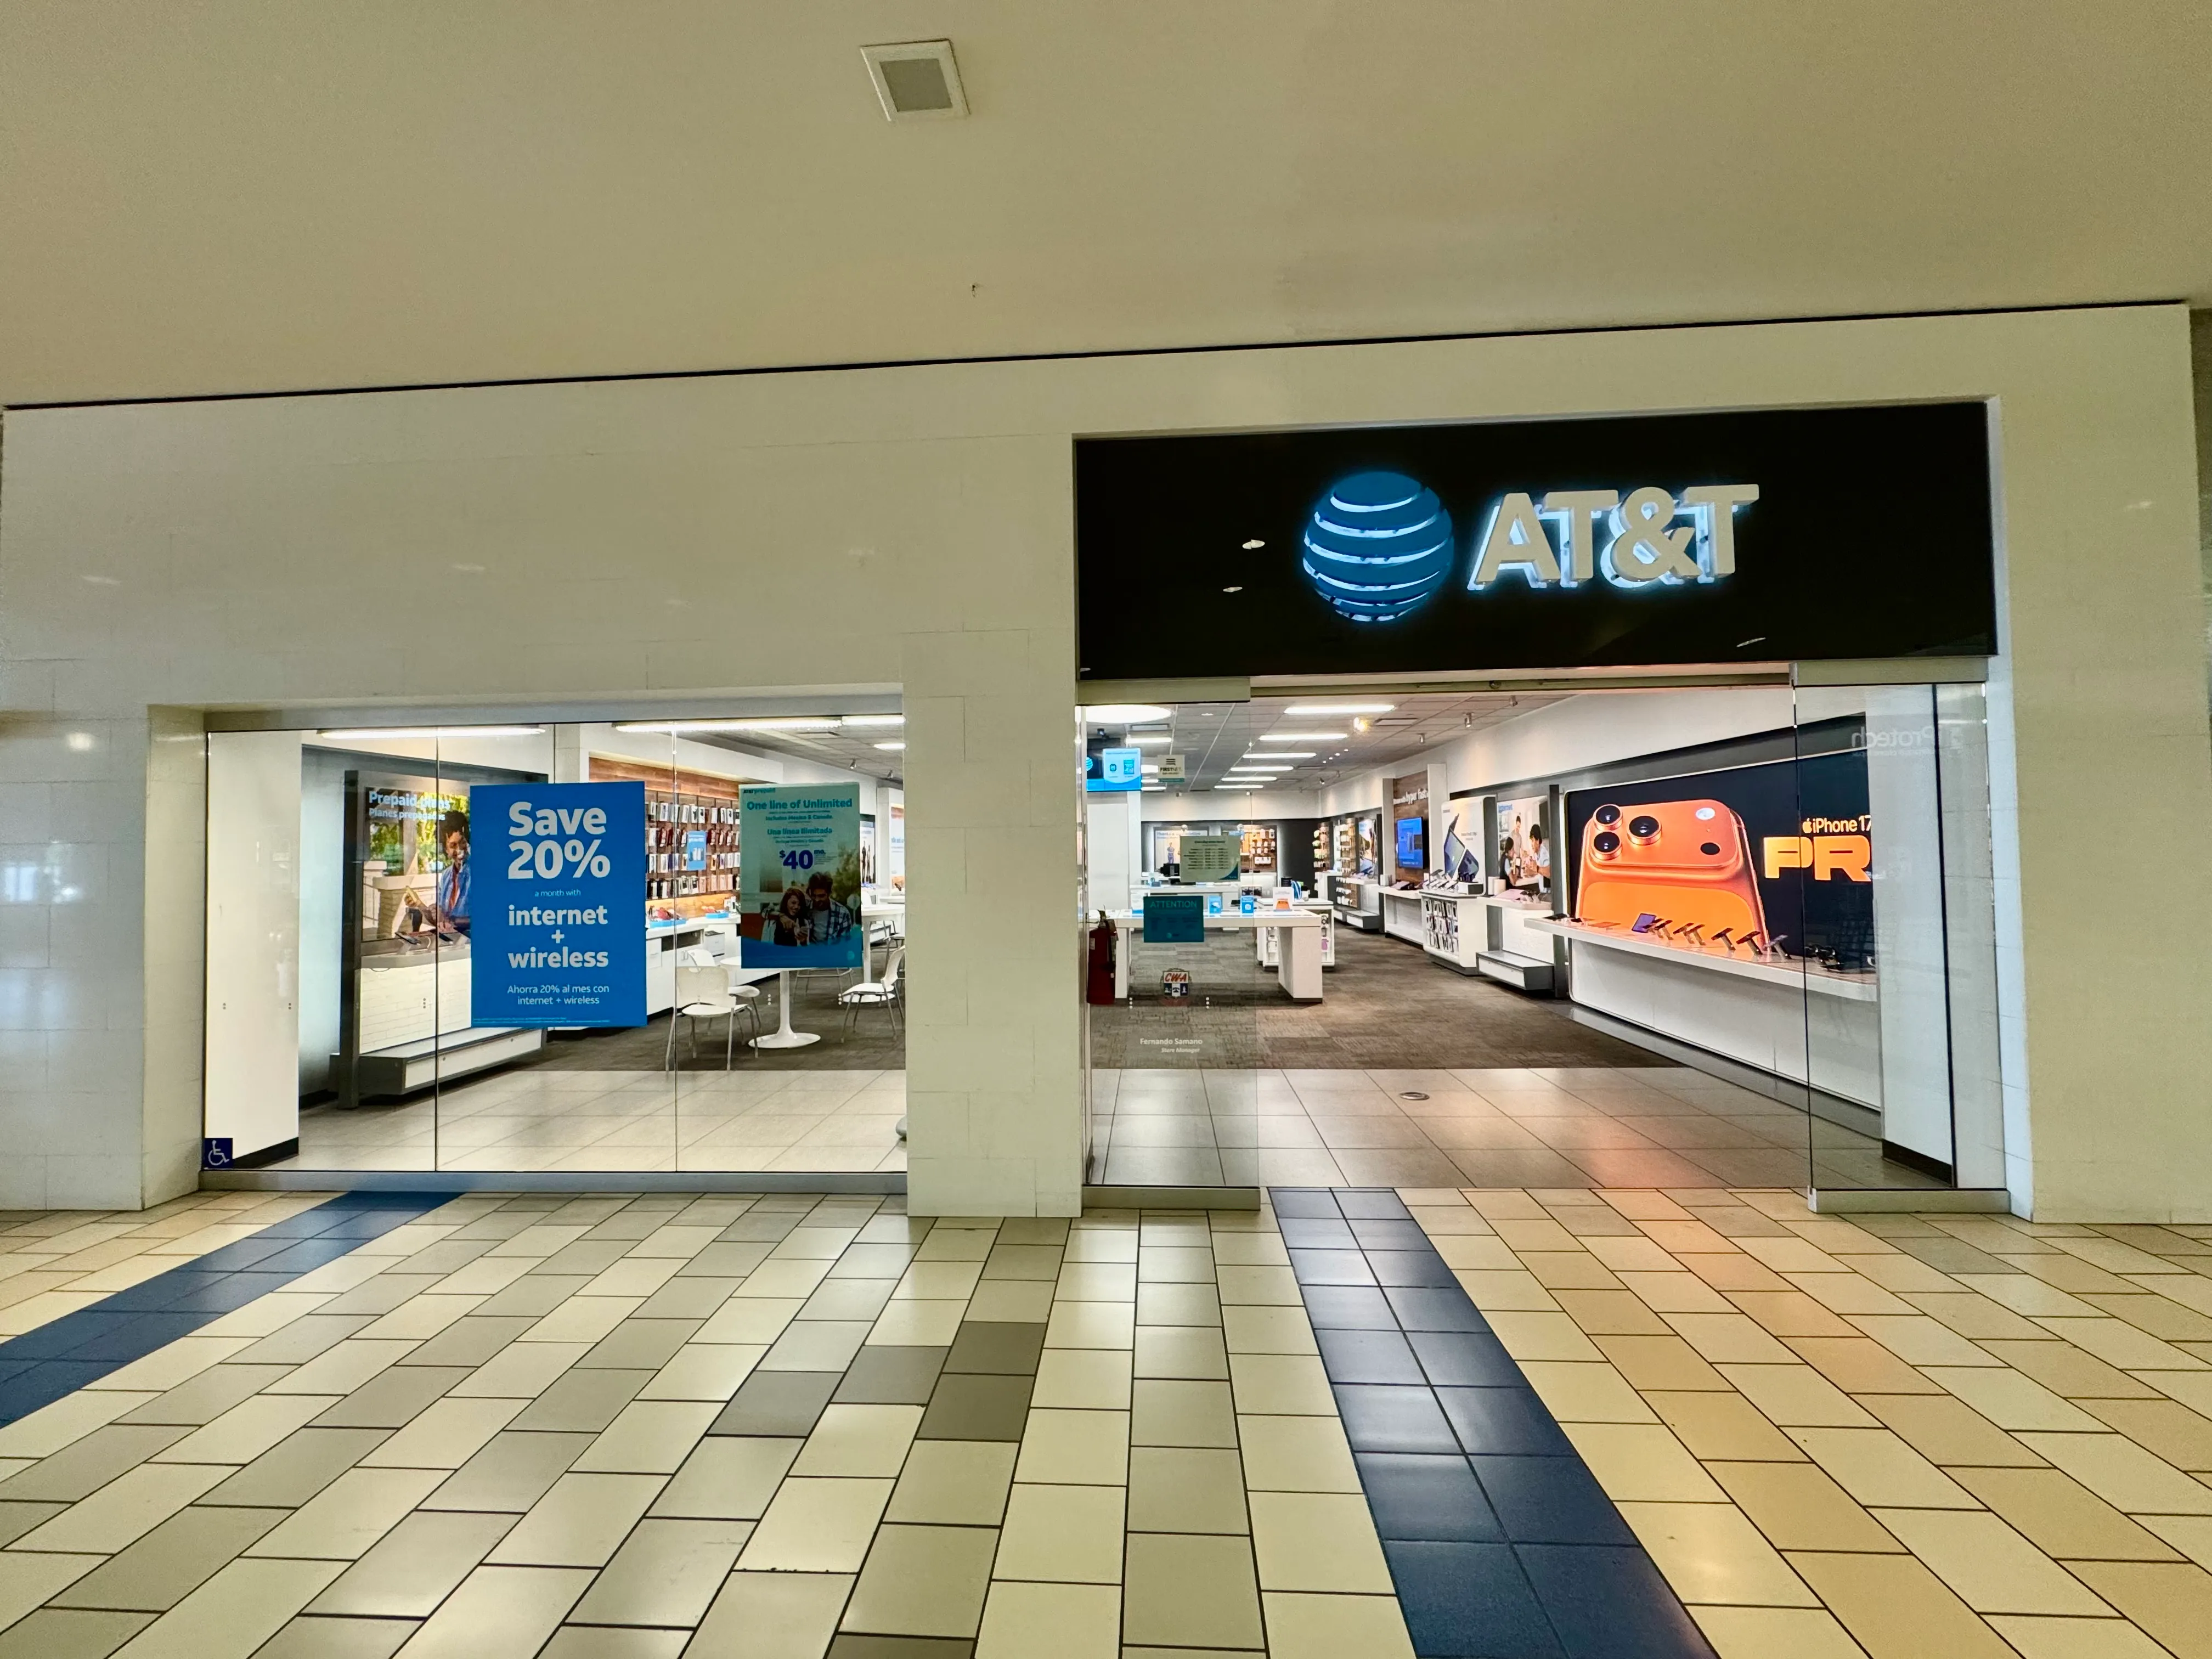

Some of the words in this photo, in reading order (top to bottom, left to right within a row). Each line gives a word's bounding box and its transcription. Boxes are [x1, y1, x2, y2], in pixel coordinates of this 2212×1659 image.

[1470, 484, 1759, 587] AT&T
[369, 791, 417, 808] Prepaid
[421, 797, 450, 809] plans
[747, 801, 767, 810] One
[769, 800, 788, 809] line
[790, 799, 802, 808] of
[803, 798, 853, 808] Unlimited
[369, 808, 397, 818] Planes
[509, 802, 607, 836] Save
[1813, 817, 1858, 833] iPhone
[1859, 815, 1872, 832] 17
[508, 839, 611, 879] 20%
[779, 849, 813, 870] $40
[1763, 835, 1871, 882] PR
[1150, 900, 1197, 909] ATTENTION
[509, 905, 608, 926] internet
[551, 929, 565, 944] +
[508, 946, 609, 968] wireless
[1165, 973, 1187, 982] CWA
[507, 985, 538, 994] Ahorra
[540, 985, 560, 994] 20%
[517, 996, 553, 1005] internet
[564, 996, 599, 1004] wireless
